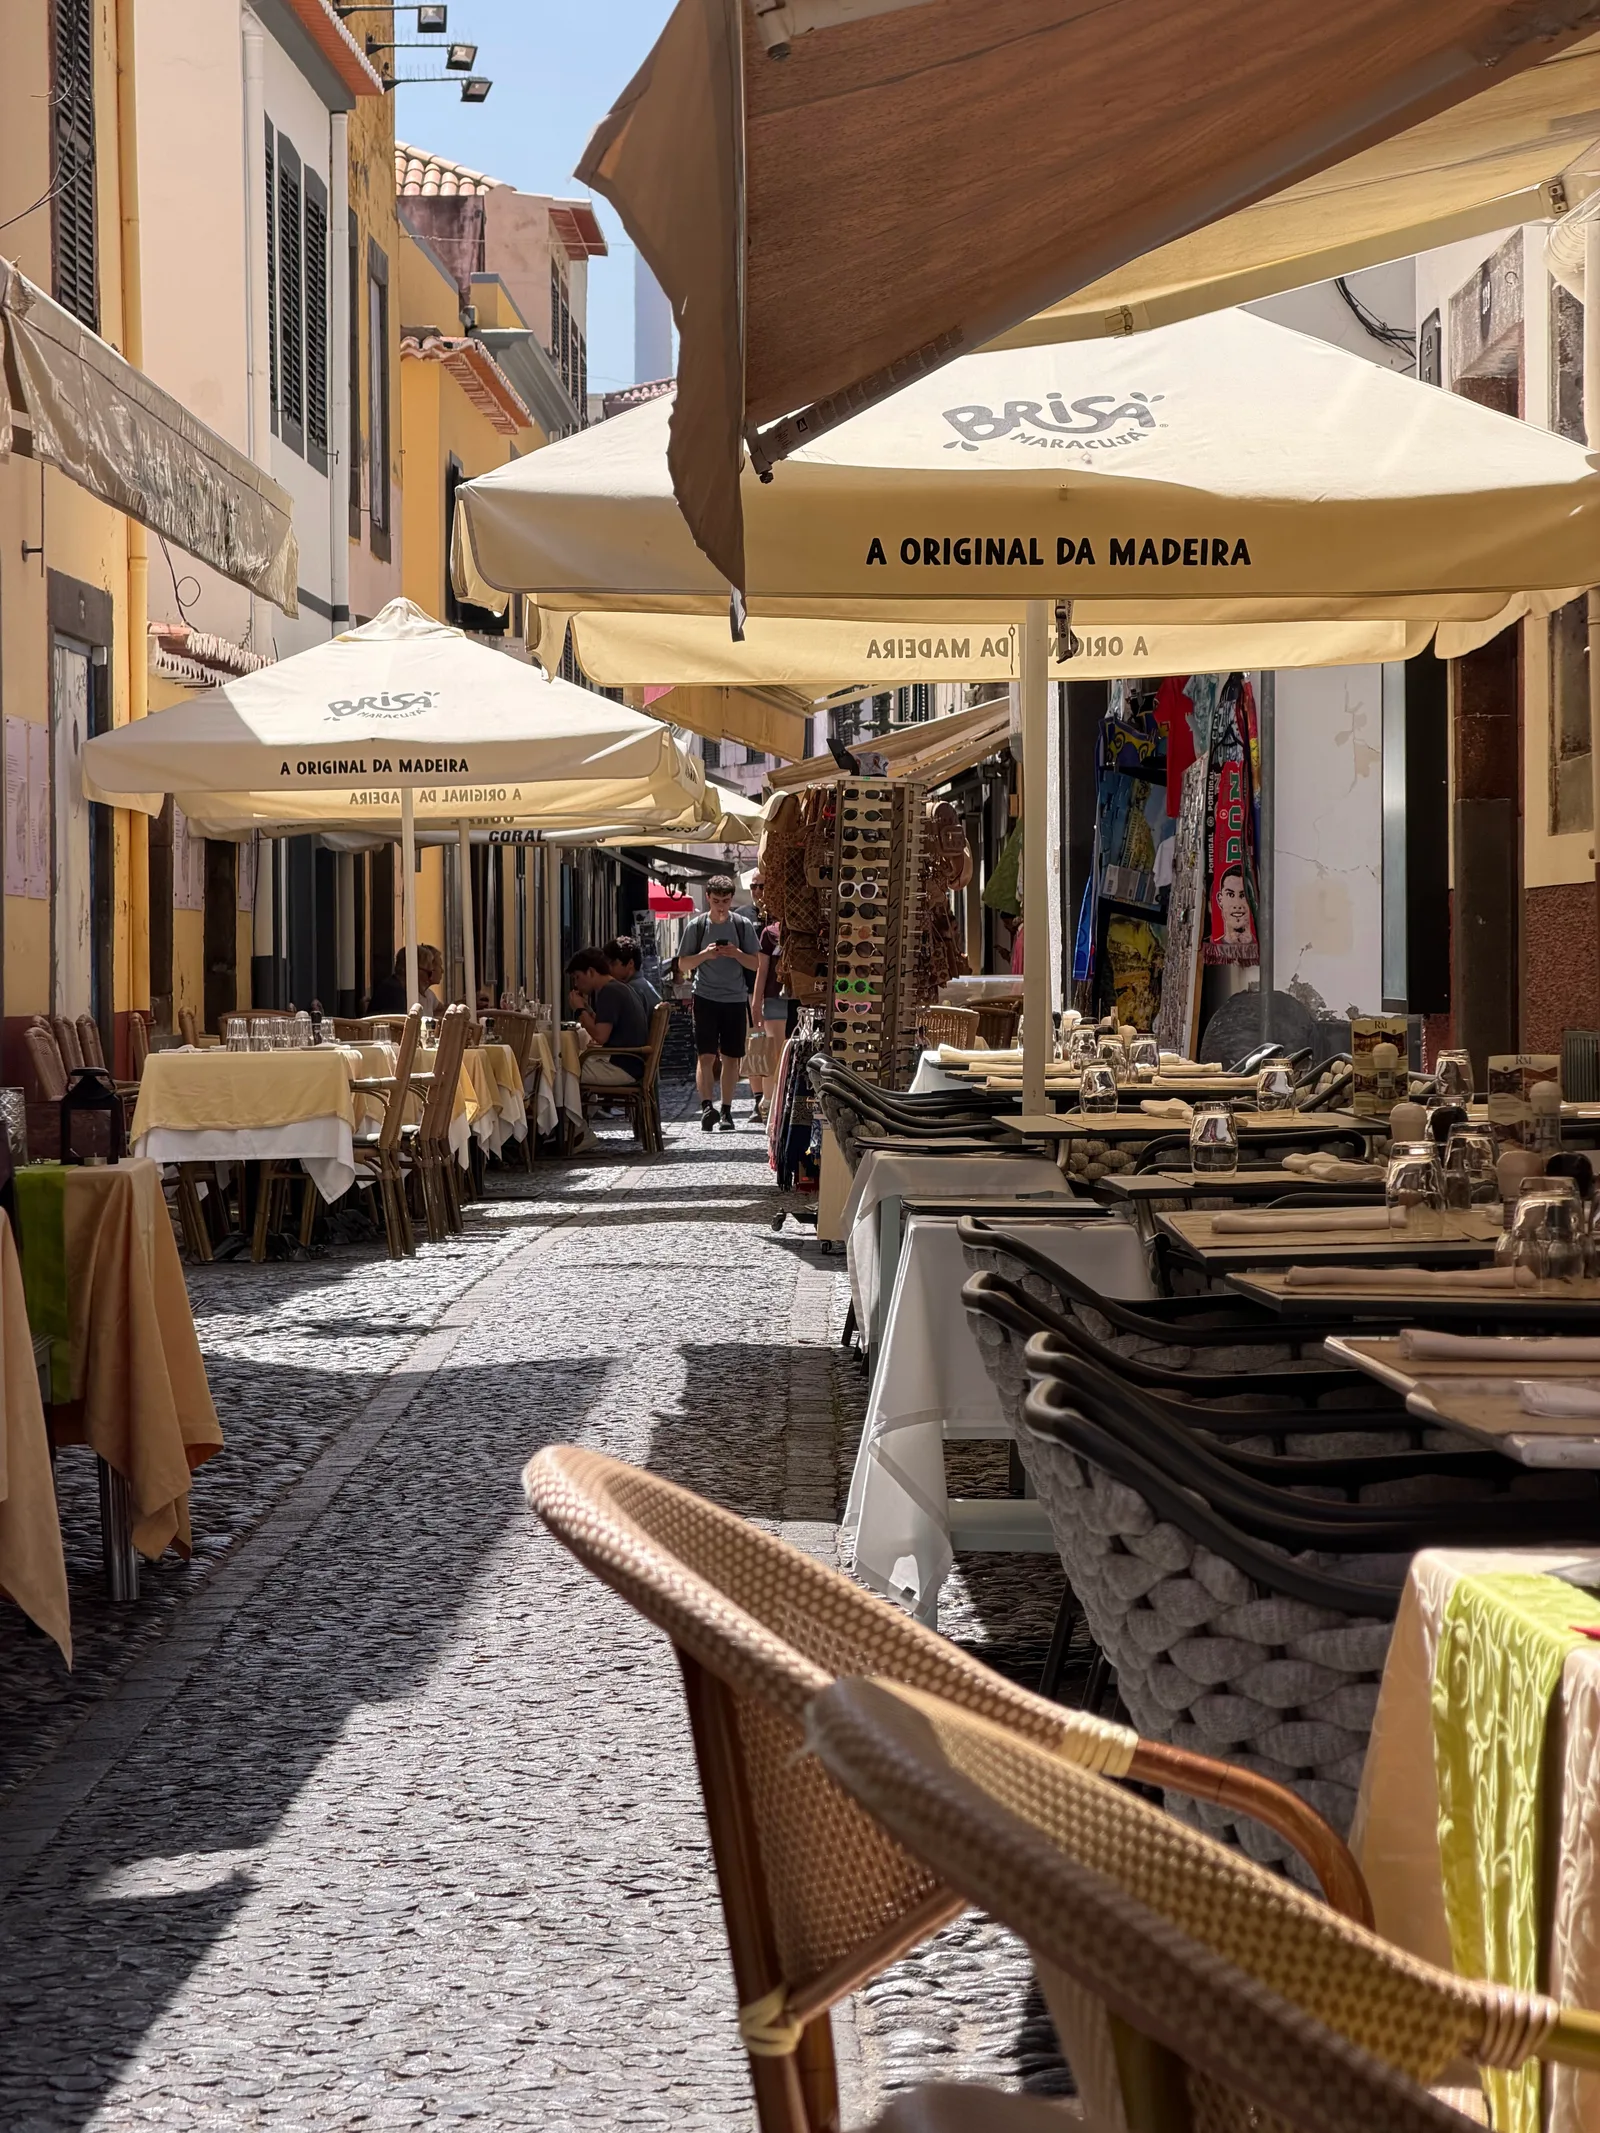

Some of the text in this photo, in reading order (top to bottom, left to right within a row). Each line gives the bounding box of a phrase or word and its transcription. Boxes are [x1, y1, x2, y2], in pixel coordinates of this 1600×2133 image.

[1009, 427, 1149, 449] MARACUJÁ
[866, 537, 1252, 567] A ORIGINAL DA MADEIRA
[280, 758, 469, 776] A ORIGINAL DA MADEIRA
[488, 829, 547, 843] CORAL
